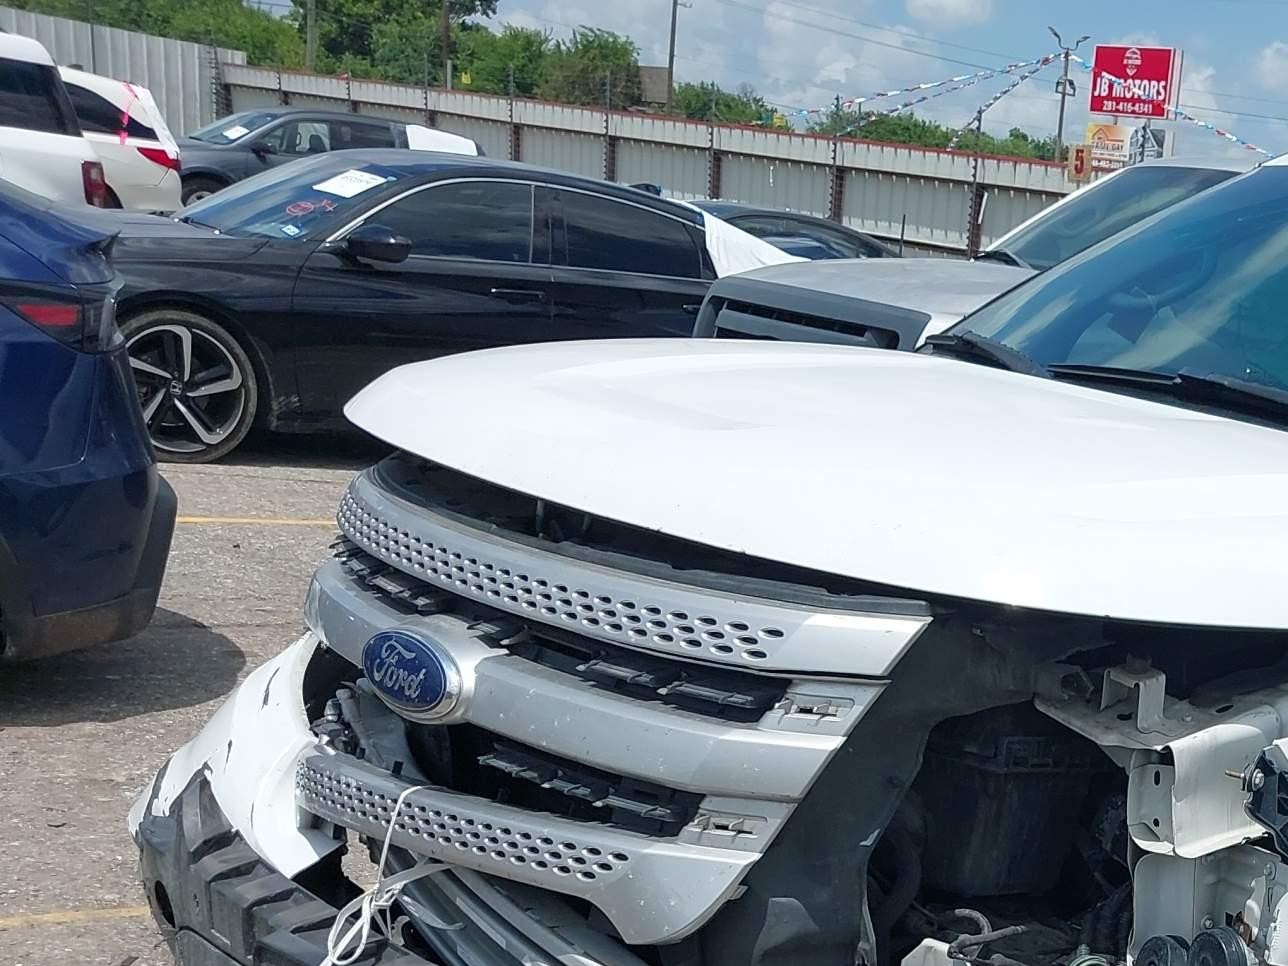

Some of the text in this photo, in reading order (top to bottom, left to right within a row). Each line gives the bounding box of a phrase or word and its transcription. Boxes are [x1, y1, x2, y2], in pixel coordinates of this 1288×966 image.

[1093, 76, 1166, 101] JB MOTORS
[1102, 101, 1153, 114] 281-416-4341
[1074, 148, 1085, 175] 5
[373, 635, 427, 699] Ford
